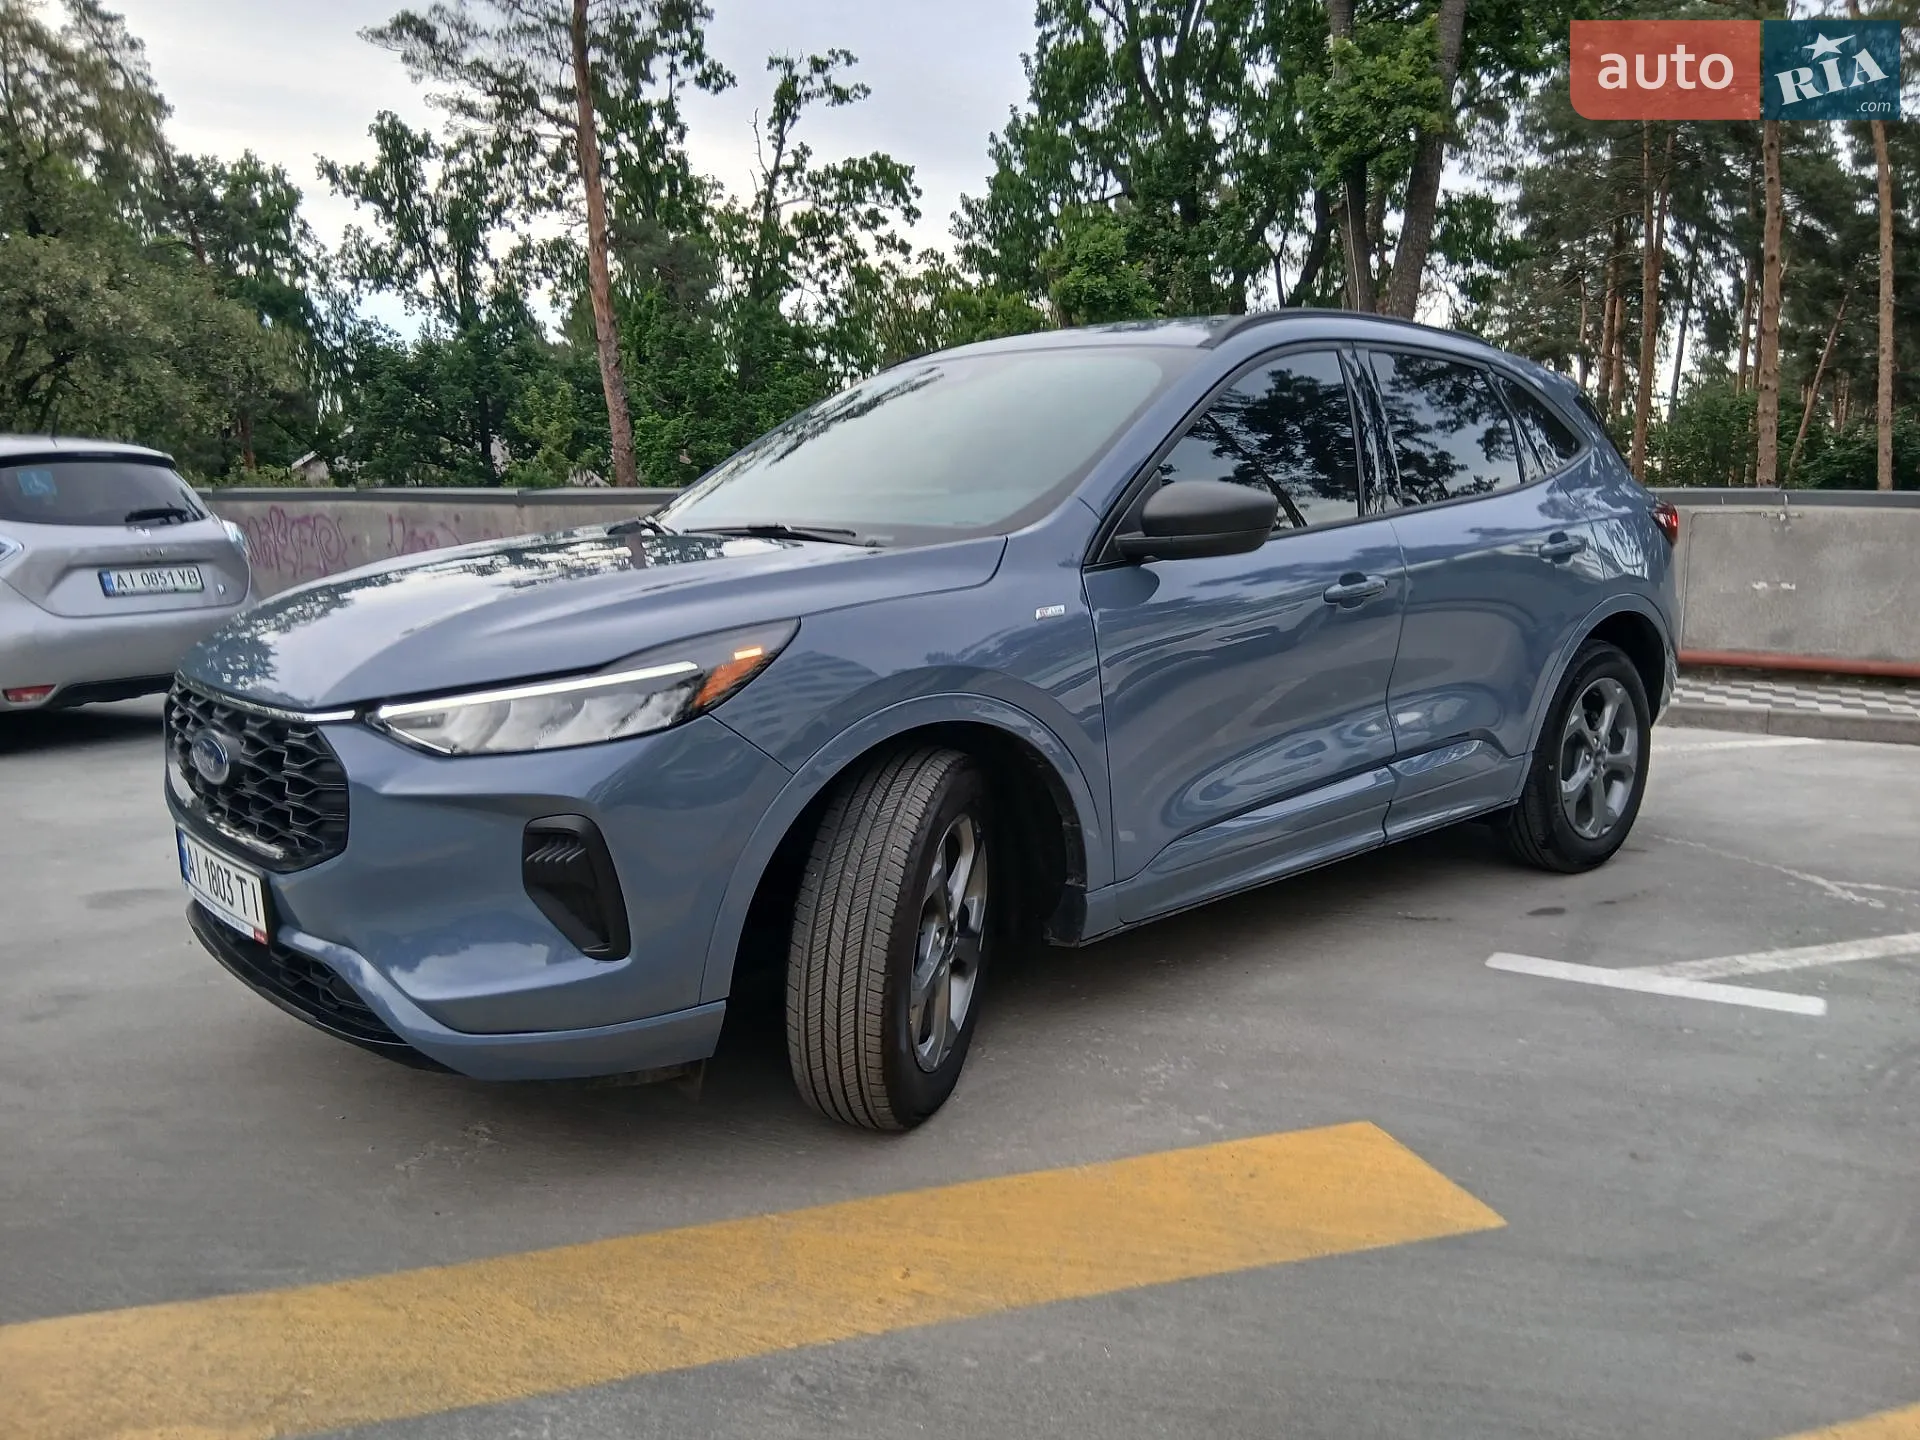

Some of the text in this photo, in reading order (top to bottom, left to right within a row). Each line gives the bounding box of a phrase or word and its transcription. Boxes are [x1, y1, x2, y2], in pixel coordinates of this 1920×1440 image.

[116, 571, 135, 589] AI
[141, 570, 176, 587] 0851
[187, 842, 202, 885] AI
[204, 856, 234, 907] 1803
